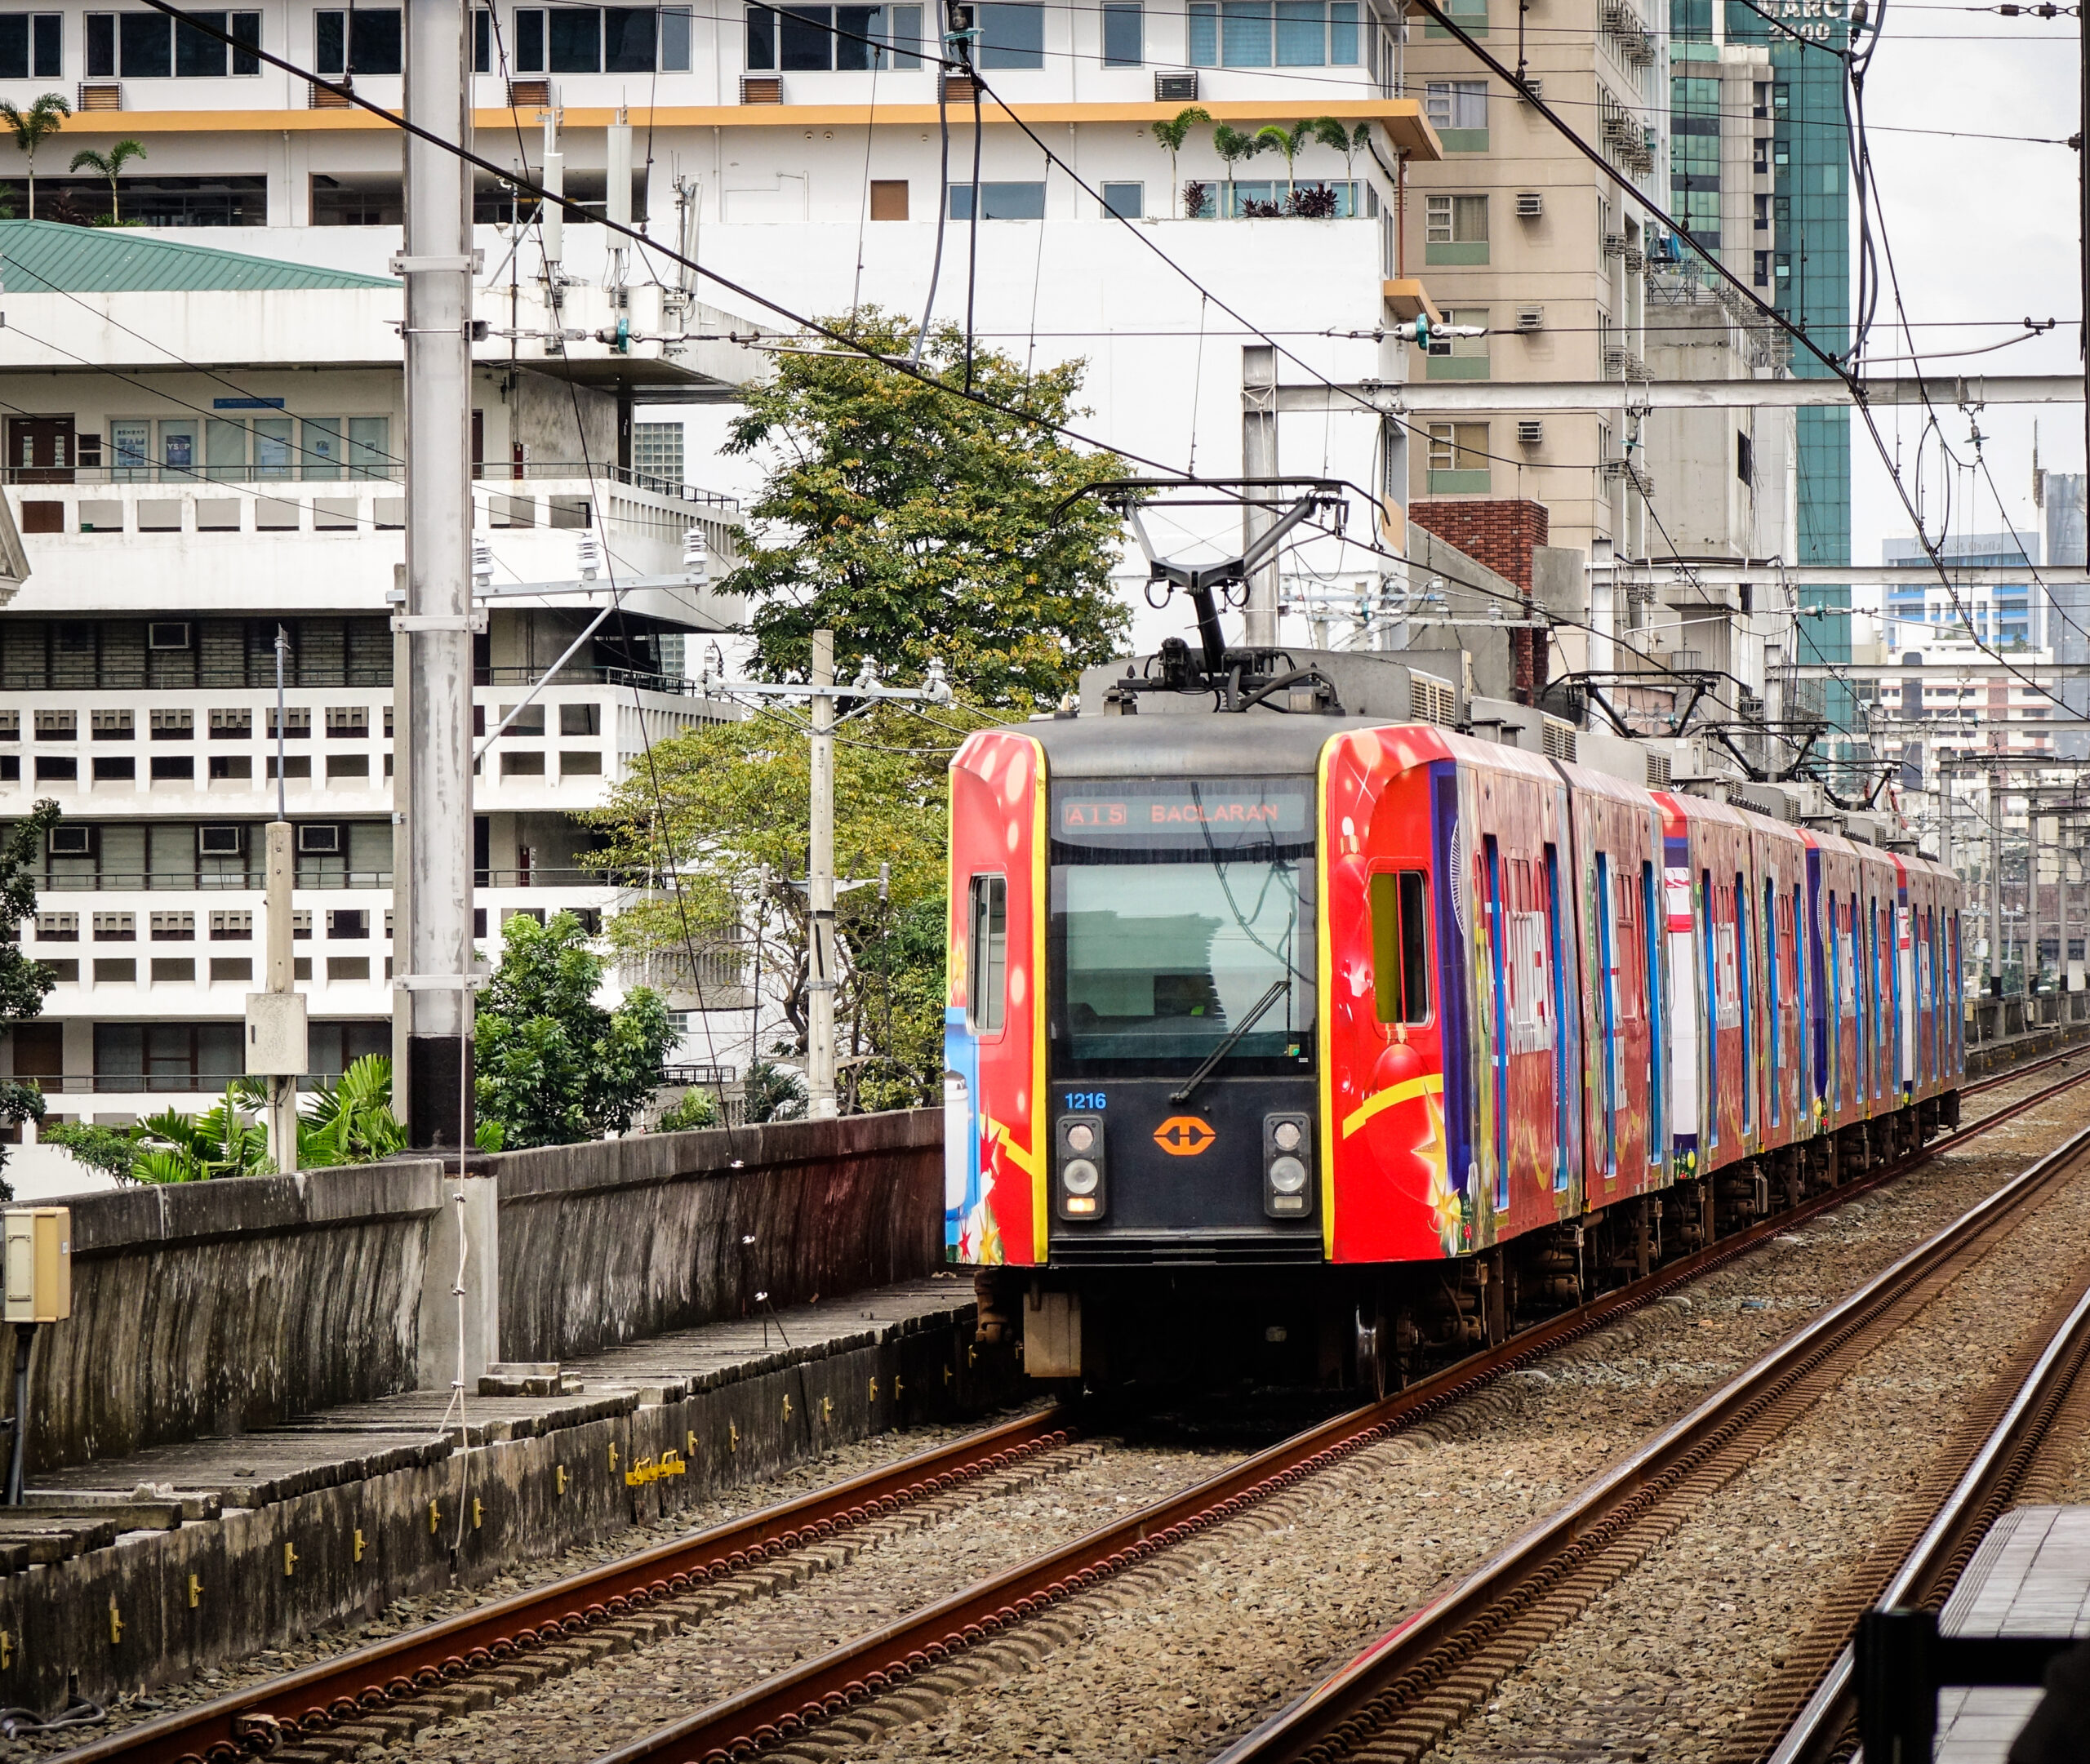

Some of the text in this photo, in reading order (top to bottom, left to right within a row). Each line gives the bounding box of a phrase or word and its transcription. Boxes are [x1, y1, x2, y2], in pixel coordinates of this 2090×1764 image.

[1757, 0, 1843, 18] MARC
[1768, 23, 1830, 42] 2000
[1069, 804, 1278, 824] A15 BACLARAN
[1065, 1092, 1107, 1109] 1216
